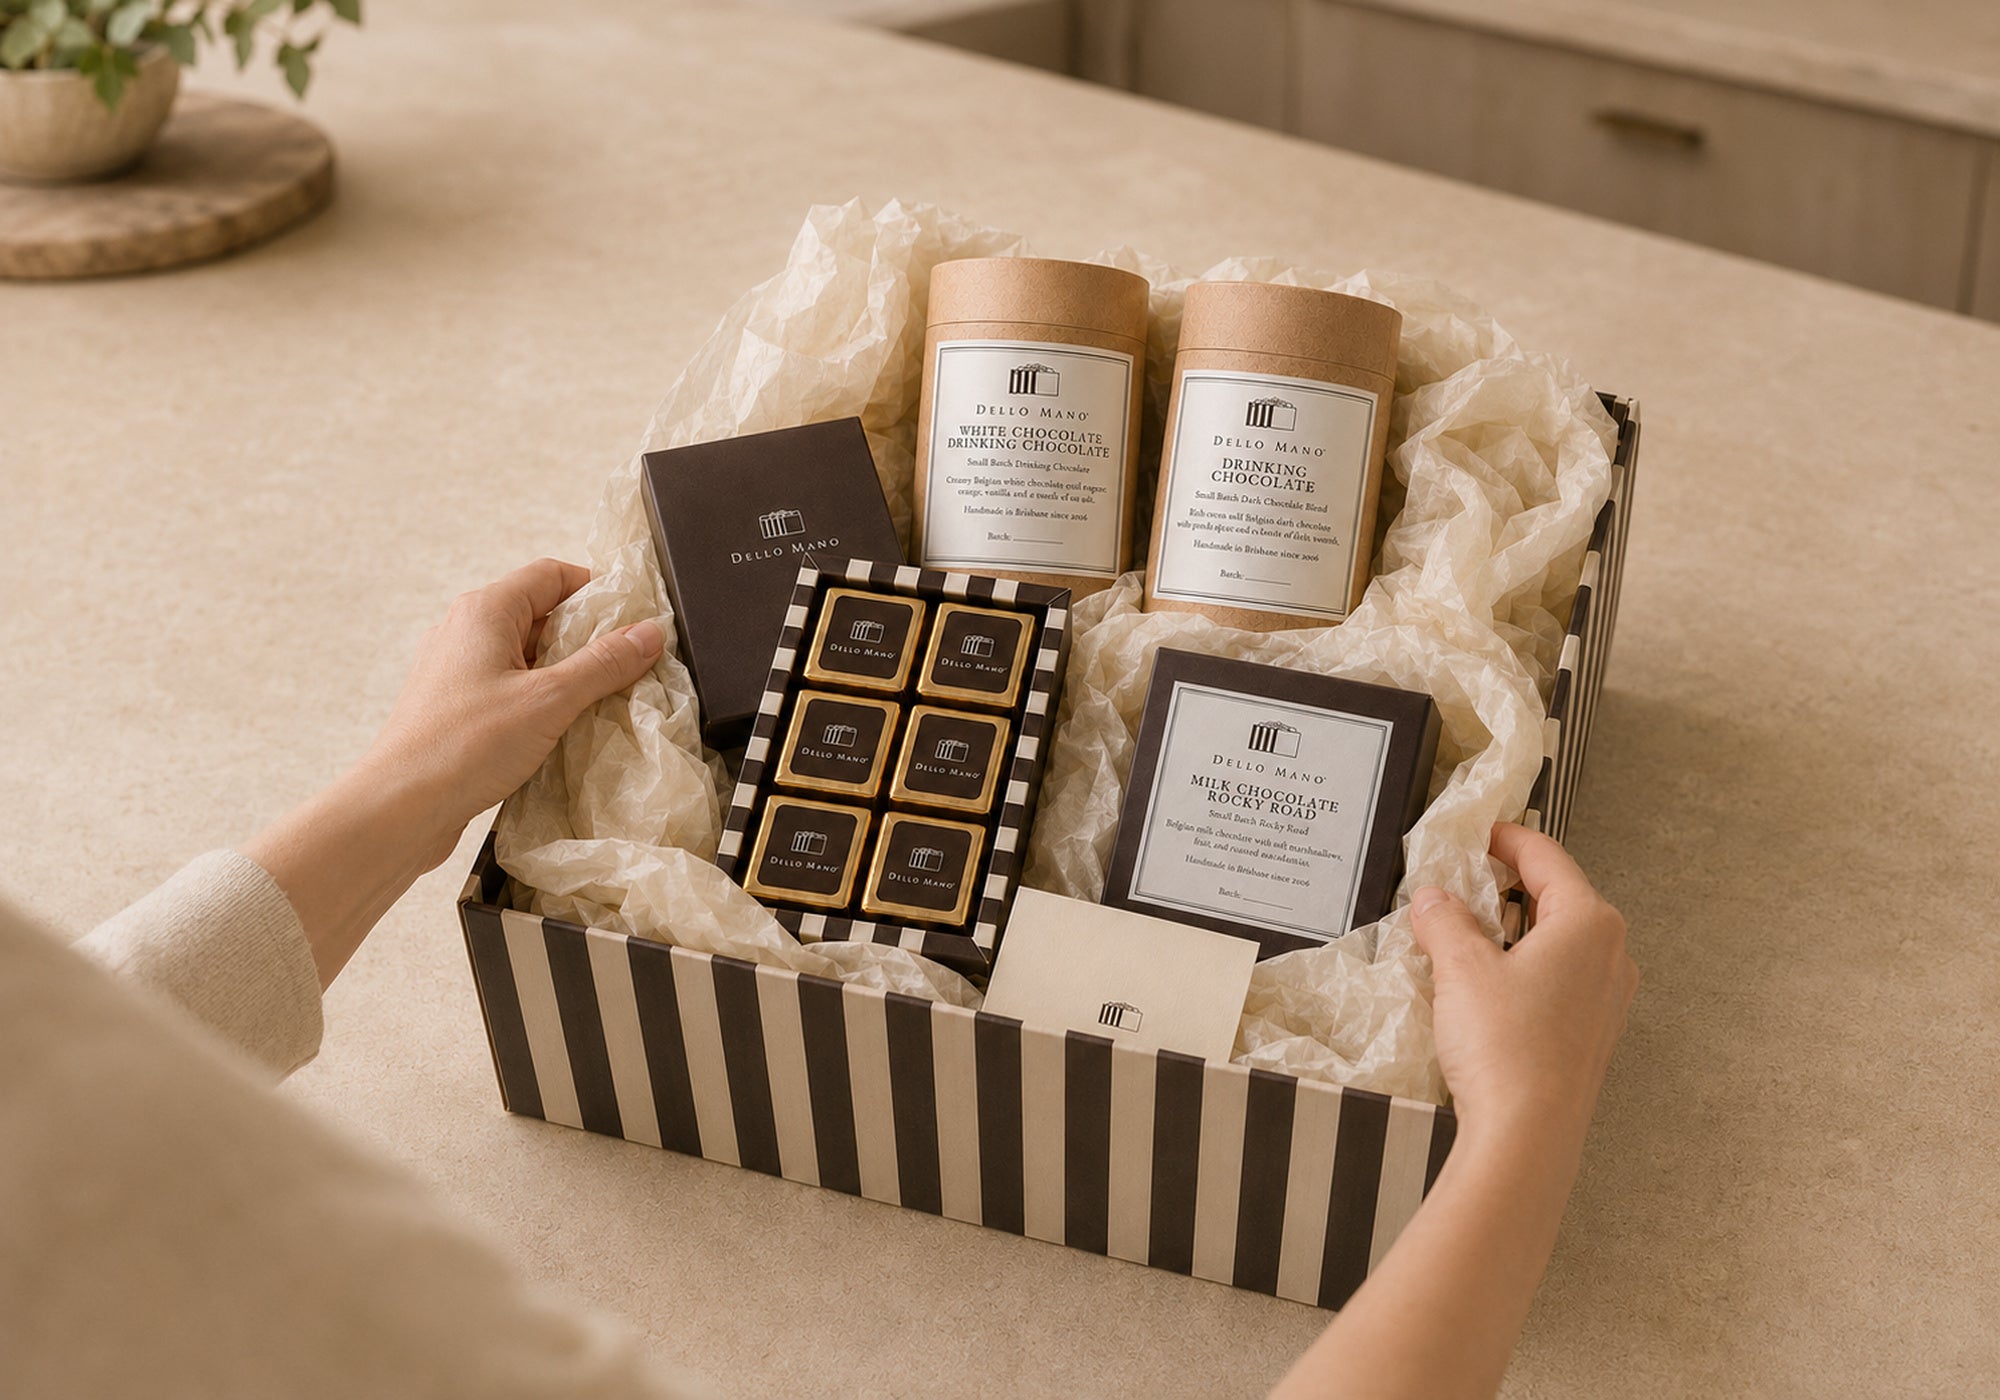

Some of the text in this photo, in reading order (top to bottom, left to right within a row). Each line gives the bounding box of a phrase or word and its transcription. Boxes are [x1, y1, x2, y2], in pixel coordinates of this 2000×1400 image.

[960, 426, 1103, 444] WHITE CHOCOLATE
[948, 438, 1110, 458] DRINKING CHOCOLATE
[967, 458, 988, 466] Small
[1053, 463, 1090, 473] Chocolate
[1222, 457, 1307, 478] DRINKING
[1211, 470, 1315, 493] CHOCOLATE
[963, 505, 1088, 521] Handmade in Brisbane since 2006
[1195, 491, 1215, 499] Small
[1241, 495, 1261, 504] Dark
[1264, 498, 1303, 510] Chocolate
[1306, 503, 1328, 513] Blend
[731, 538, 839, 564] DELLO MANO
[1193, 539, 1319, 562] Handmade in Brisbane since 2006
[1190, 775, 1339, 813] MILK CHOCOLATE
[1207, 790, 1317, 821] ROCKY ROAD
[1209, 809, 1232, 821] Small
[1259, 819, 1285, 833] Rocky
[1185, 855, 1310, 888] Handmade in Brisbane since 2006
